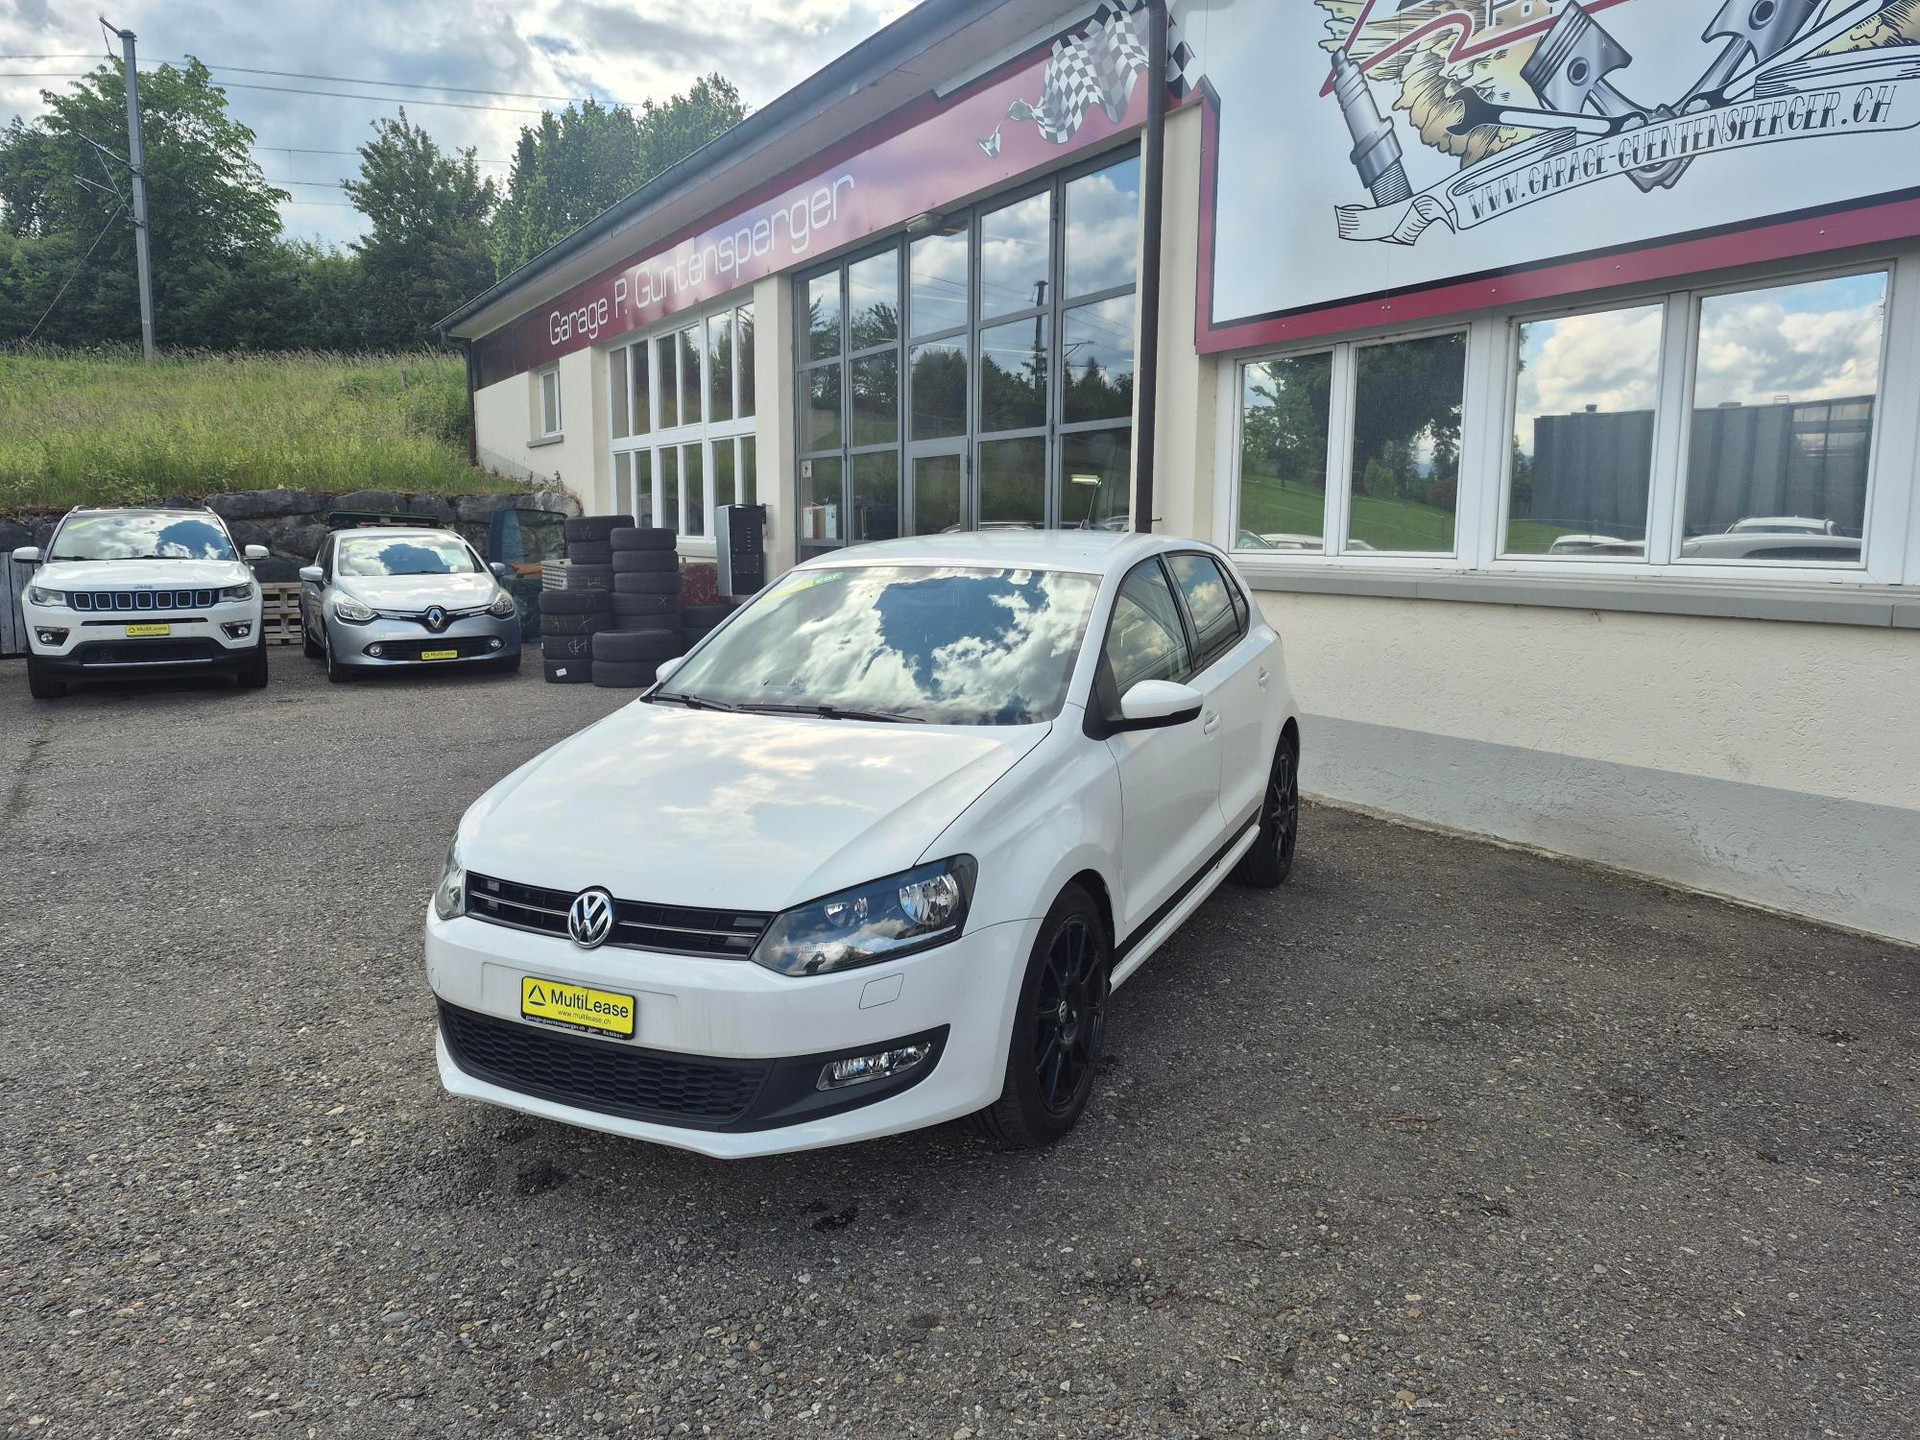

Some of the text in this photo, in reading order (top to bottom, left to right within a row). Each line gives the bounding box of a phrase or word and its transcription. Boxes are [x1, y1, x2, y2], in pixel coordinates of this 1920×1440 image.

[1467, 84, 1898, 220] WWW.GARAGE-GUENTENSPERGER.CH
[550, 174, 854, 346] Garage P. Güntensperger
[550, 988, 629, 1018] MultiLease
[557, 1009, 612, 1026] www.multilease.ch
